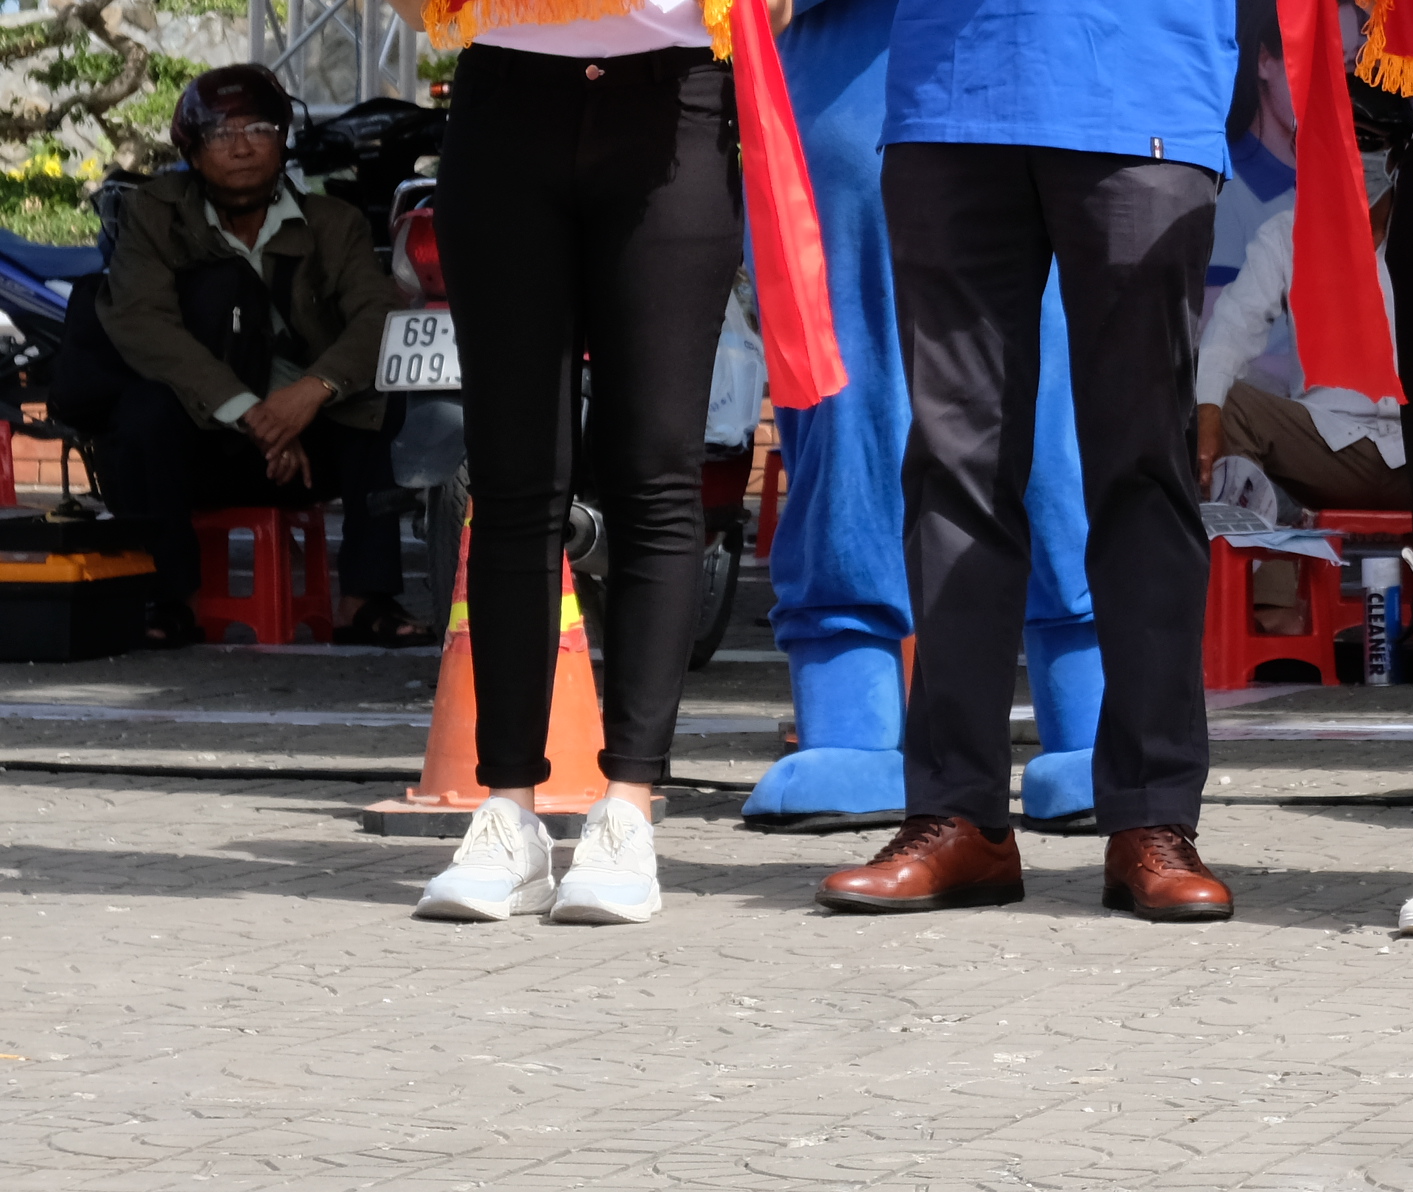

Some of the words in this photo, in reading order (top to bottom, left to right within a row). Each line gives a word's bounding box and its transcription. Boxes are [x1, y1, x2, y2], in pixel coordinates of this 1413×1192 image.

[403, 316, 456, 348] 69-
[385, 352, 460, 385] 009.
[1367, 592, 1386, 676] CLEANER
